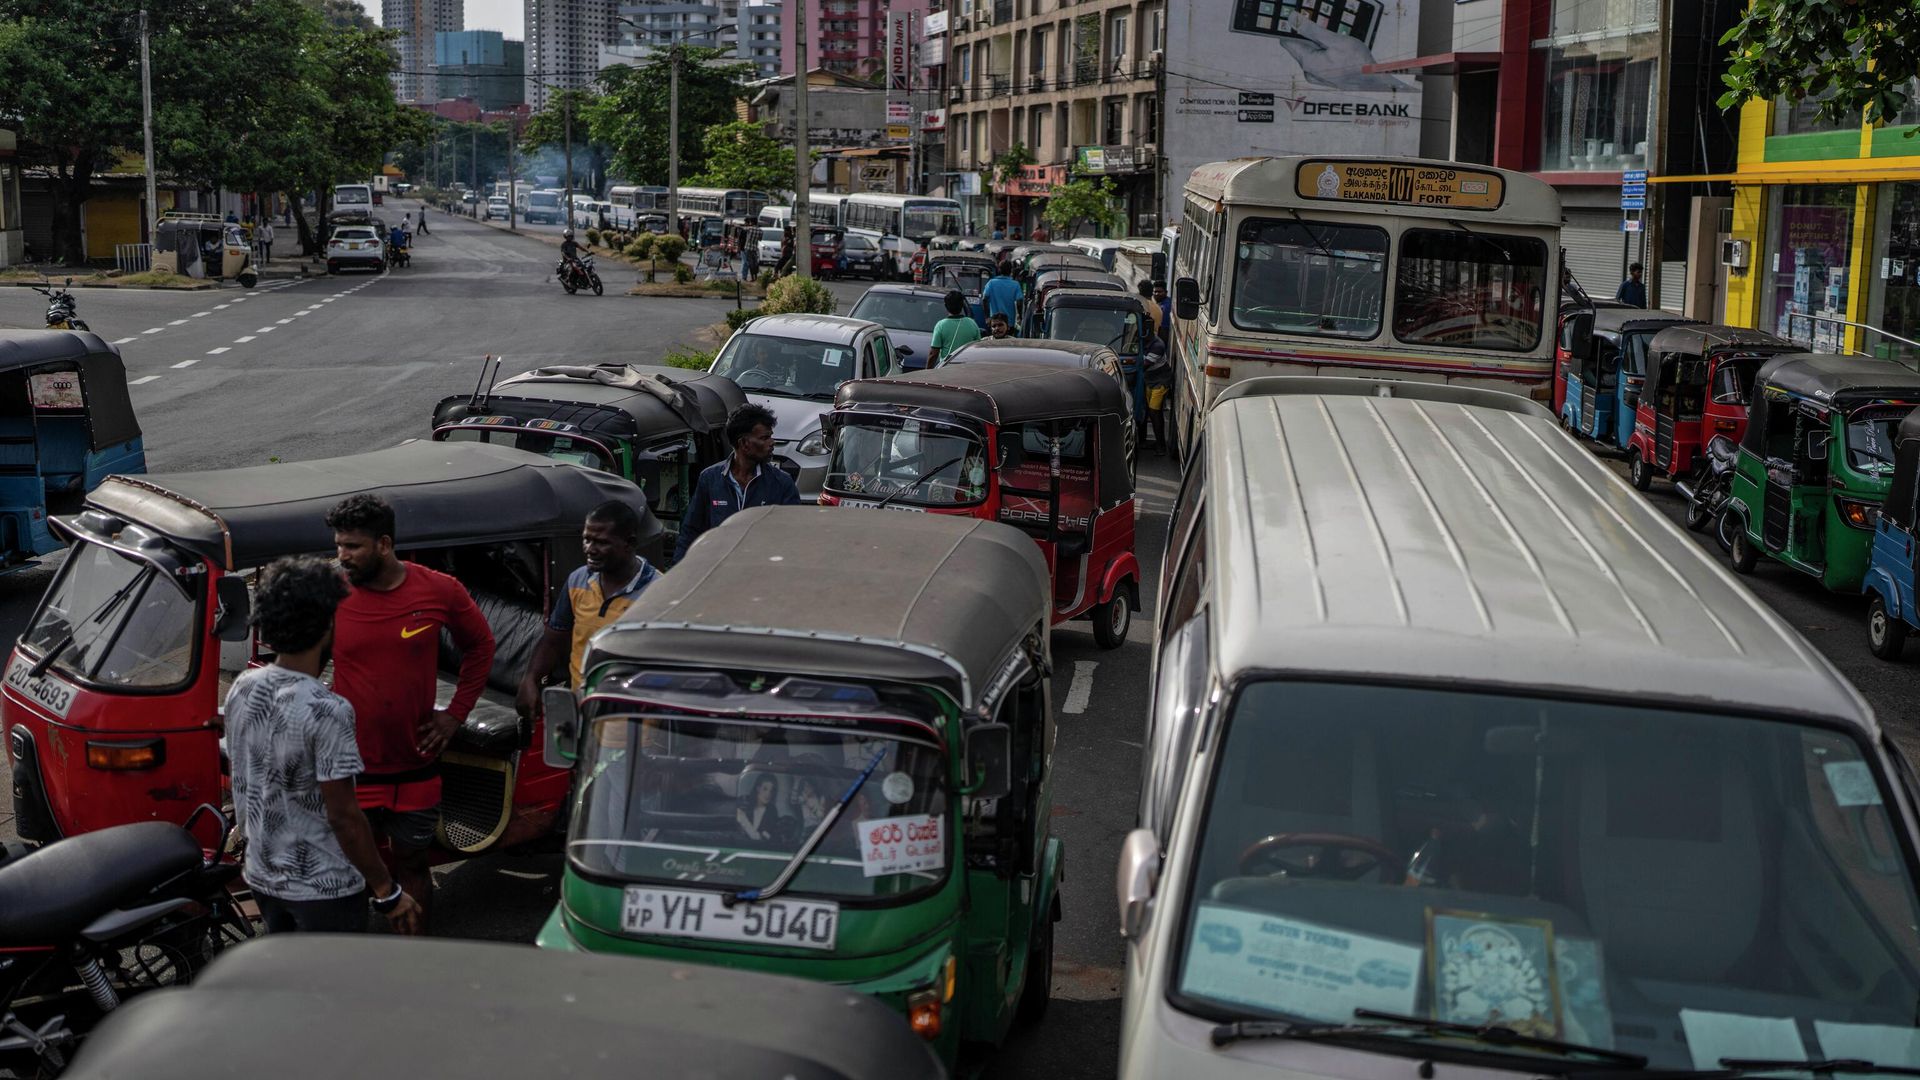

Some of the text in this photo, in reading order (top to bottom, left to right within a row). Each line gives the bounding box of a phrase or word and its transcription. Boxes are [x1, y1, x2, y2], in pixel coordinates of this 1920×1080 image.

[893, 18, 904, 74] NDB bank
[1179, 97, 1211, 105] Download
[1303, 102, 1409, 117] DFCC BANK
[1353, 117, 1375, 127] Keep
[1390, 168, 1414, 202] 107
[1343, 192, 1386, 201] ELAKANDA
[1419, 194, 1452, 204] FORT
[825, 350, 837, 365] L
[1001, 507, 1089, 527] PORSCHE
[626, 907, 653, 928] WP
